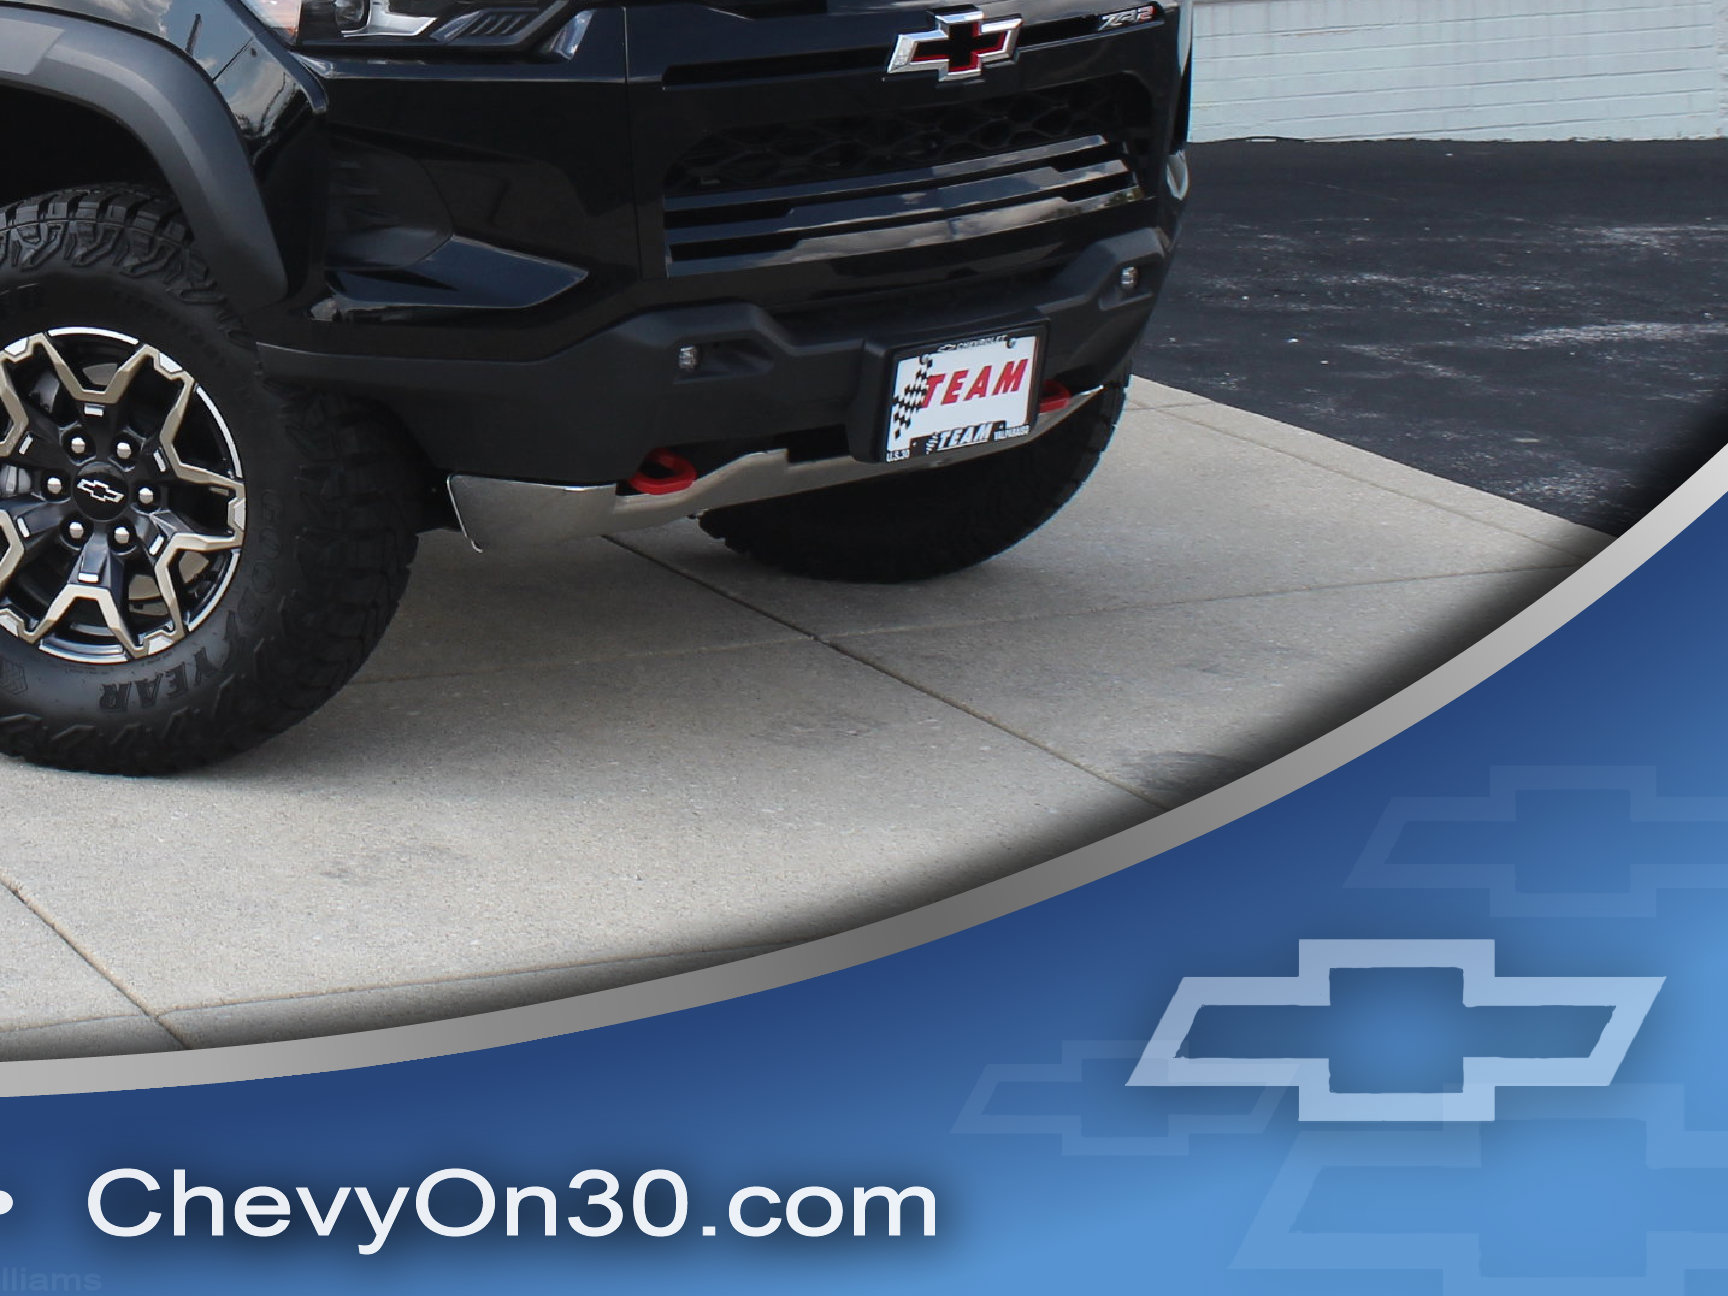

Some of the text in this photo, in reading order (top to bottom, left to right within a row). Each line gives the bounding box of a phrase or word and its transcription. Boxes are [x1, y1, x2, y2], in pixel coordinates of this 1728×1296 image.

[1097, 5, 1157, 32] ZR2
[920, 359, 1029, 409] TEAM
[937, 422, 994, 451] TEAM
